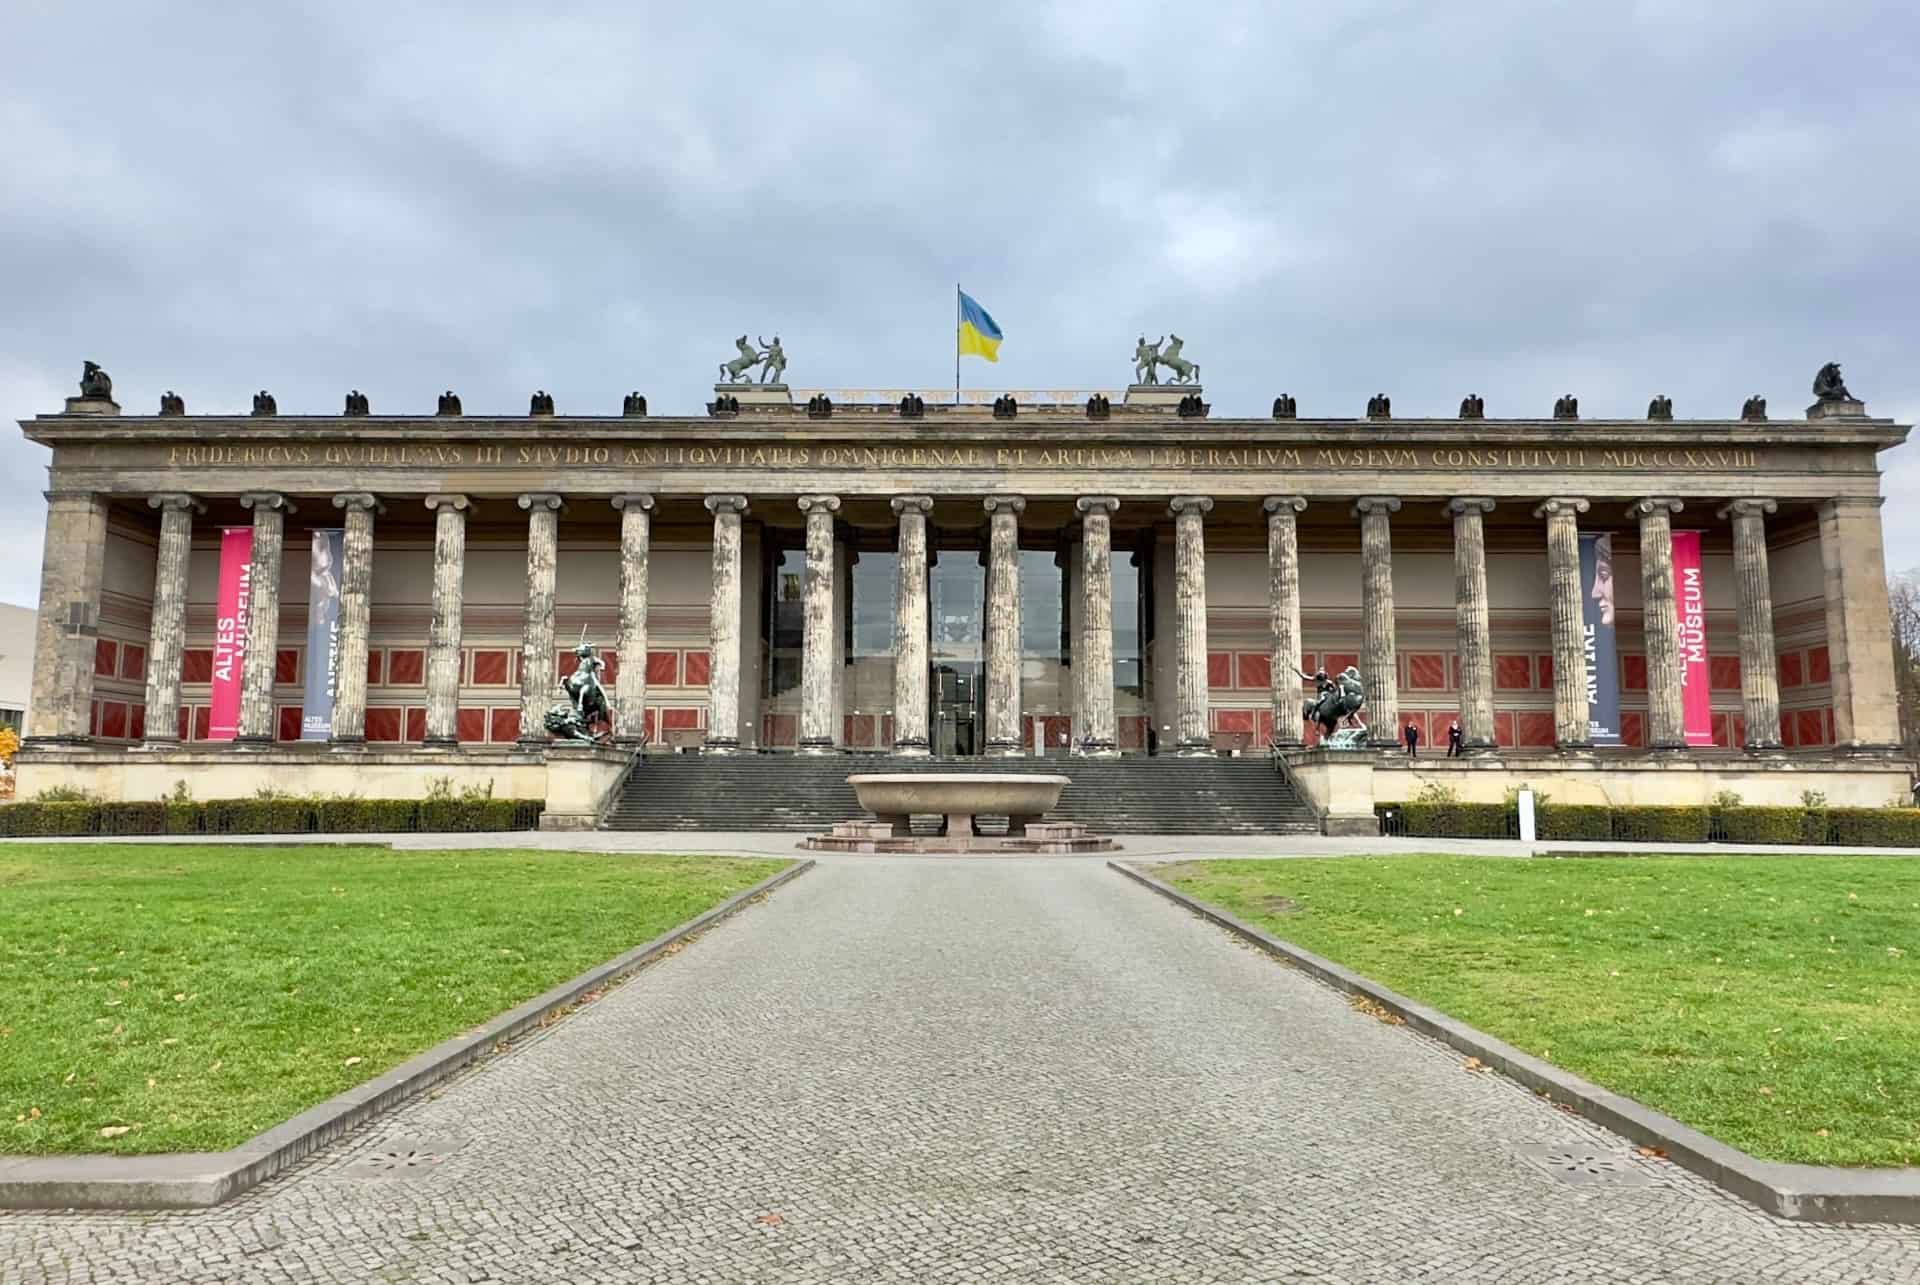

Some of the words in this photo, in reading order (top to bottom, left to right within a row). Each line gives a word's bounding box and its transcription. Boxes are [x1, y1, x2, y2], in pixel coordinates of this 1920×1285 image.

[168, 447, 311, 464] FRIDERICVS
[476, 447, 502, 464] III
[518, 447, 610, 464] STVDIO
[624, 448, 810, 465] ANTIQVITATIS
[823, 448, 980, 465] OMNIGENAE
[997, 449, 1027, 465] ET
[1038, 449, 1137, 465] ARTIVM
[1149, 449, 1303, 465] LIBERALIVM
[1315, 449, 1420, 466] MVSEVM
[1432, 450, 1586, 466] CONSTITVIT
[1600, 450, 1757, 466] MDCCCXXVIII
[1682, 567, 1704, 662] MUSEUM
[214, 617, 235, 682] ALTES
